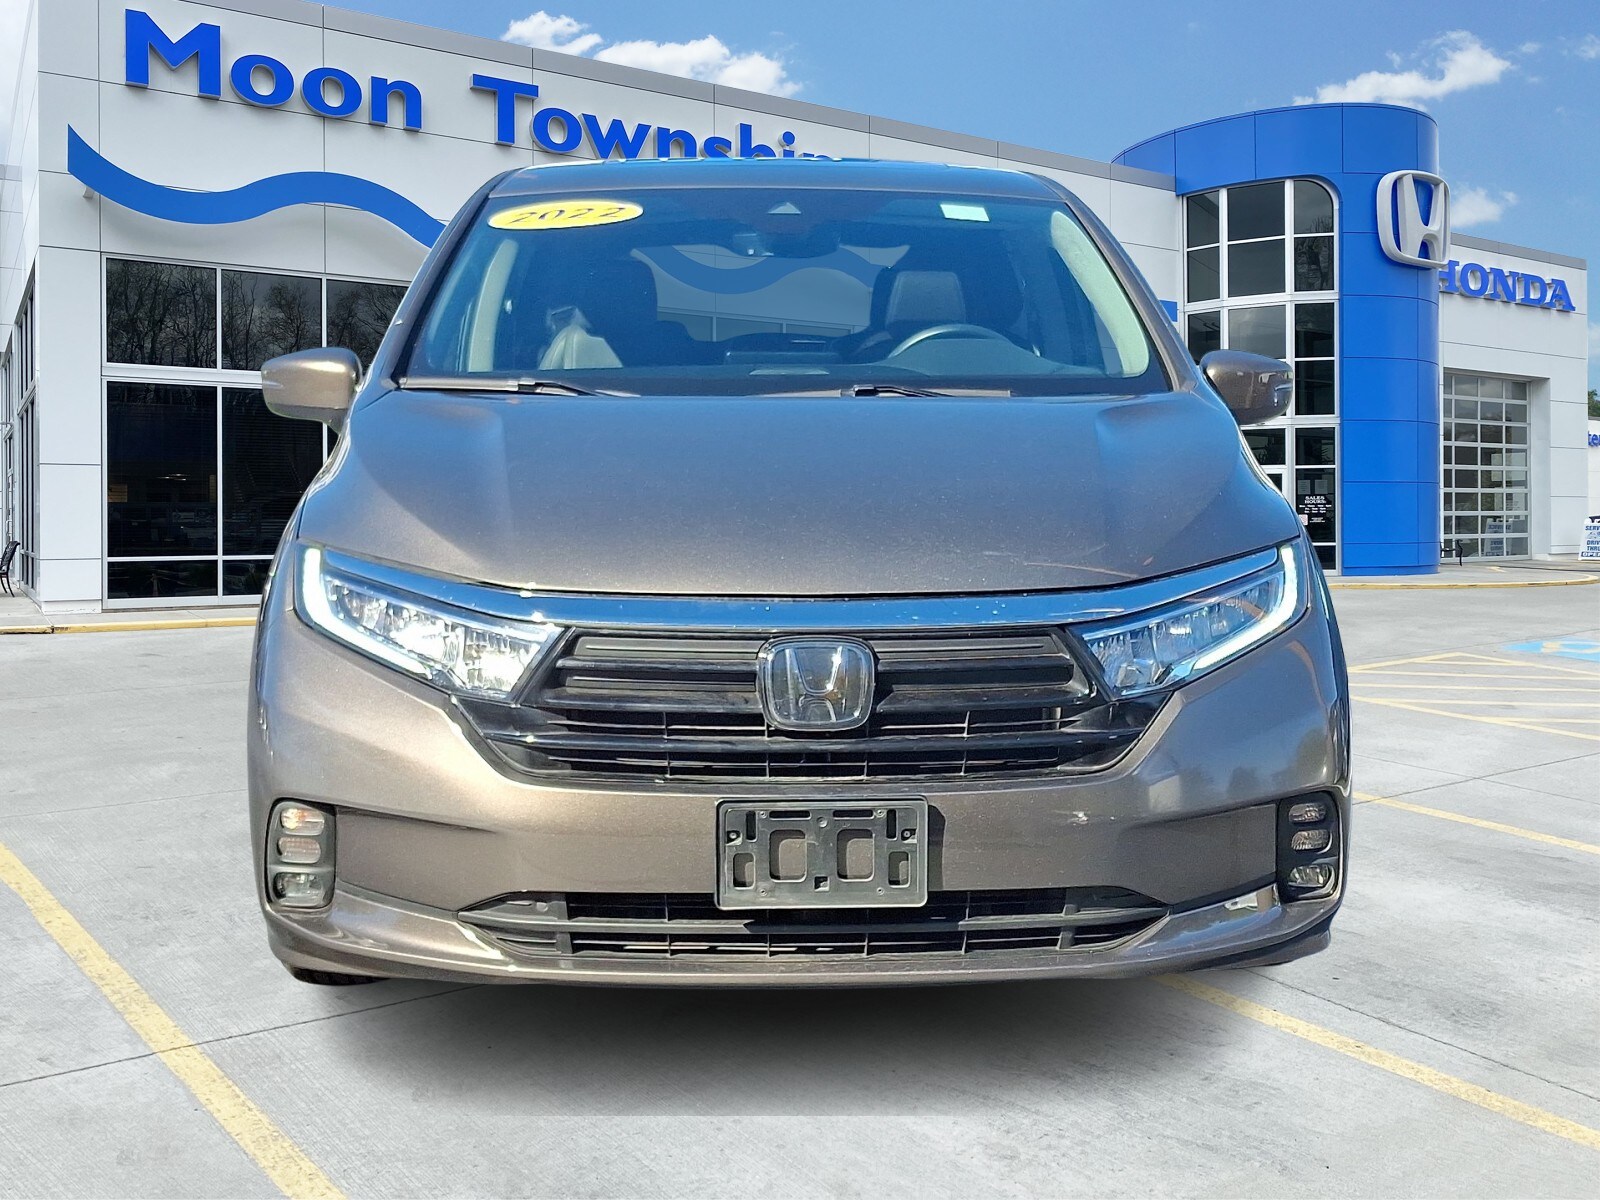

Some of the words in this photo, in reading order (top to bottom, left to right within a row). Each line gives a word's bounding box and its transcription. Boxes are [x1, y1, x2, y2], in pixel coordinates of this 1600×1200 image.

[125, 9, 422, 131] Moon
[470, 73, 834, 158] Townshi
[505, 207, 626, 225] 2022
